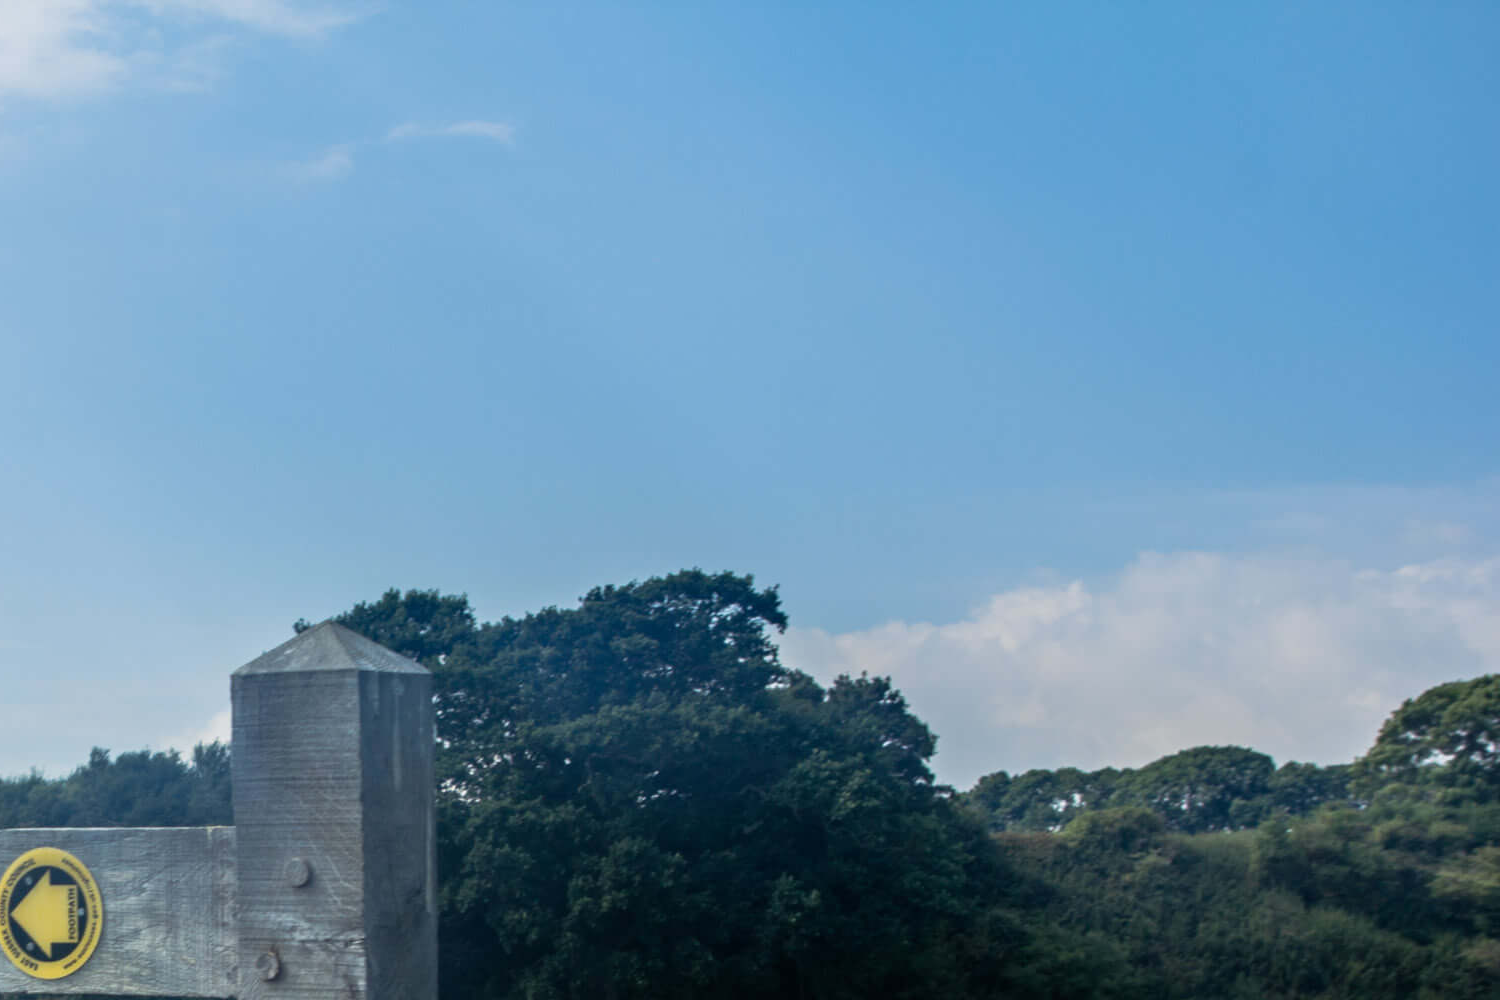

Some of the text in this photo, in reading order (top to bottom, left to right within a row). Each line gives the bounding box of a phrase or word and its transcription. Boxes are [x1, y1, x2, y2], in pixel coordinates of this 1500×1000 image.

[0, 889, 10, 926] COUNTY
[68, 887, 78, 940] FOOTPATH
[2, 928, 20, 959] SUSSEX
[20, 957, 39, 971] EAST
